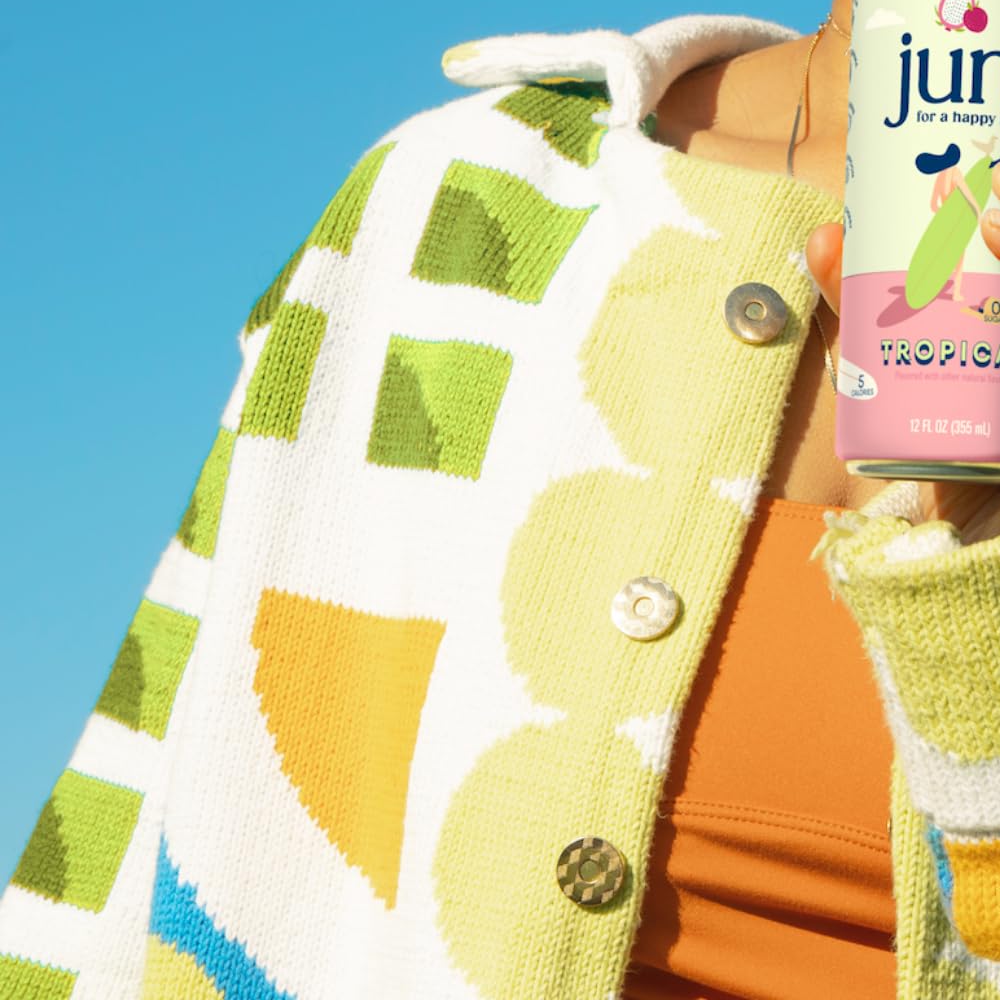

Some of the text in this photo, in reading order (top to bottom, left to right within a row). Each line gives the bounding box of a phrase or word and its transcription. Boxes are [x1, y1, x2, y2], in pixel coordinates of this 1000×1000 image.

[916, 110, 937, 123] for
[940, 113, 948, 122] a
[952, 111, 995, 127] happy
[991, 301, 1000, 315] 0
[858, 374, 865, 388] 5
[909, 418, 920, 433] 12
[935, 419, 948, 434] OZ
[951, 420, 972, 436] (355
[974, 421, 991, 438] mL)
